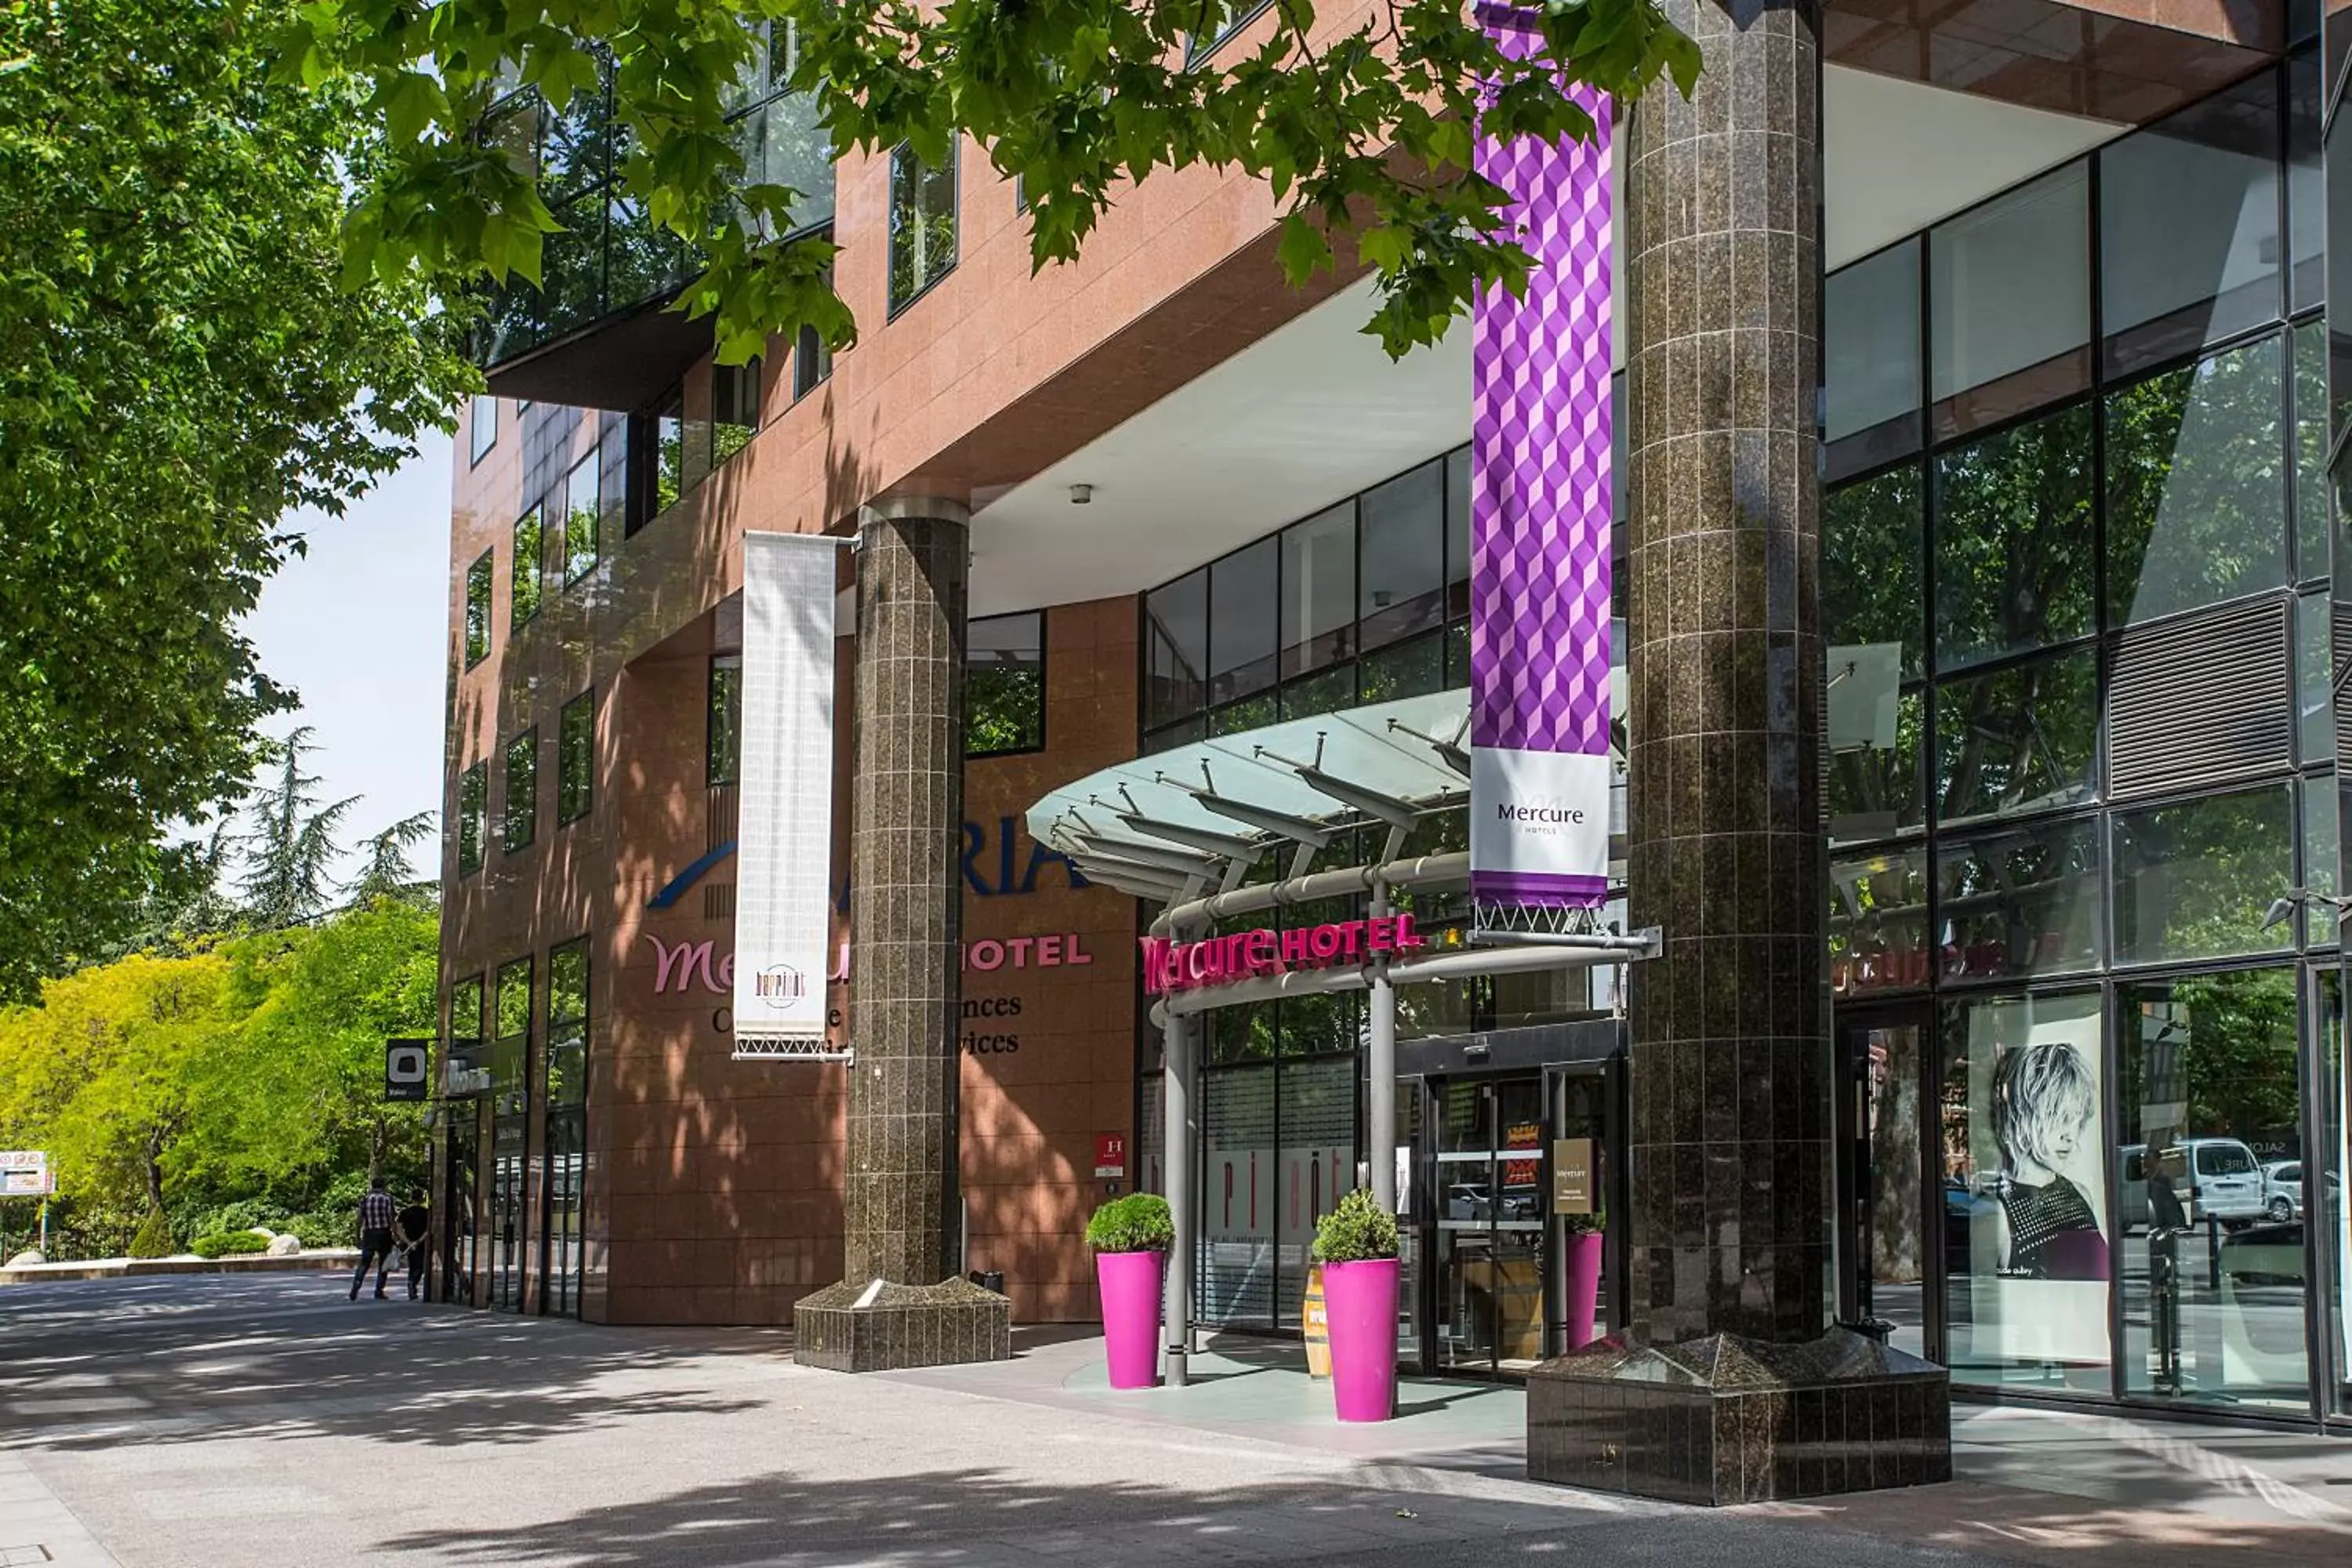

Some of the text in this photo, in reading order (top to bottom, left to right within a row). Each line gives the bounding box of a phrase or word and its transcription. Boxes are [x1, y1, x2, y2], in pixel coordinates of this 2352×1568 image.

[1498, 804, 1584, 824] Mercure
[1139, 913, 1427, 994] Mercure HOTEL
